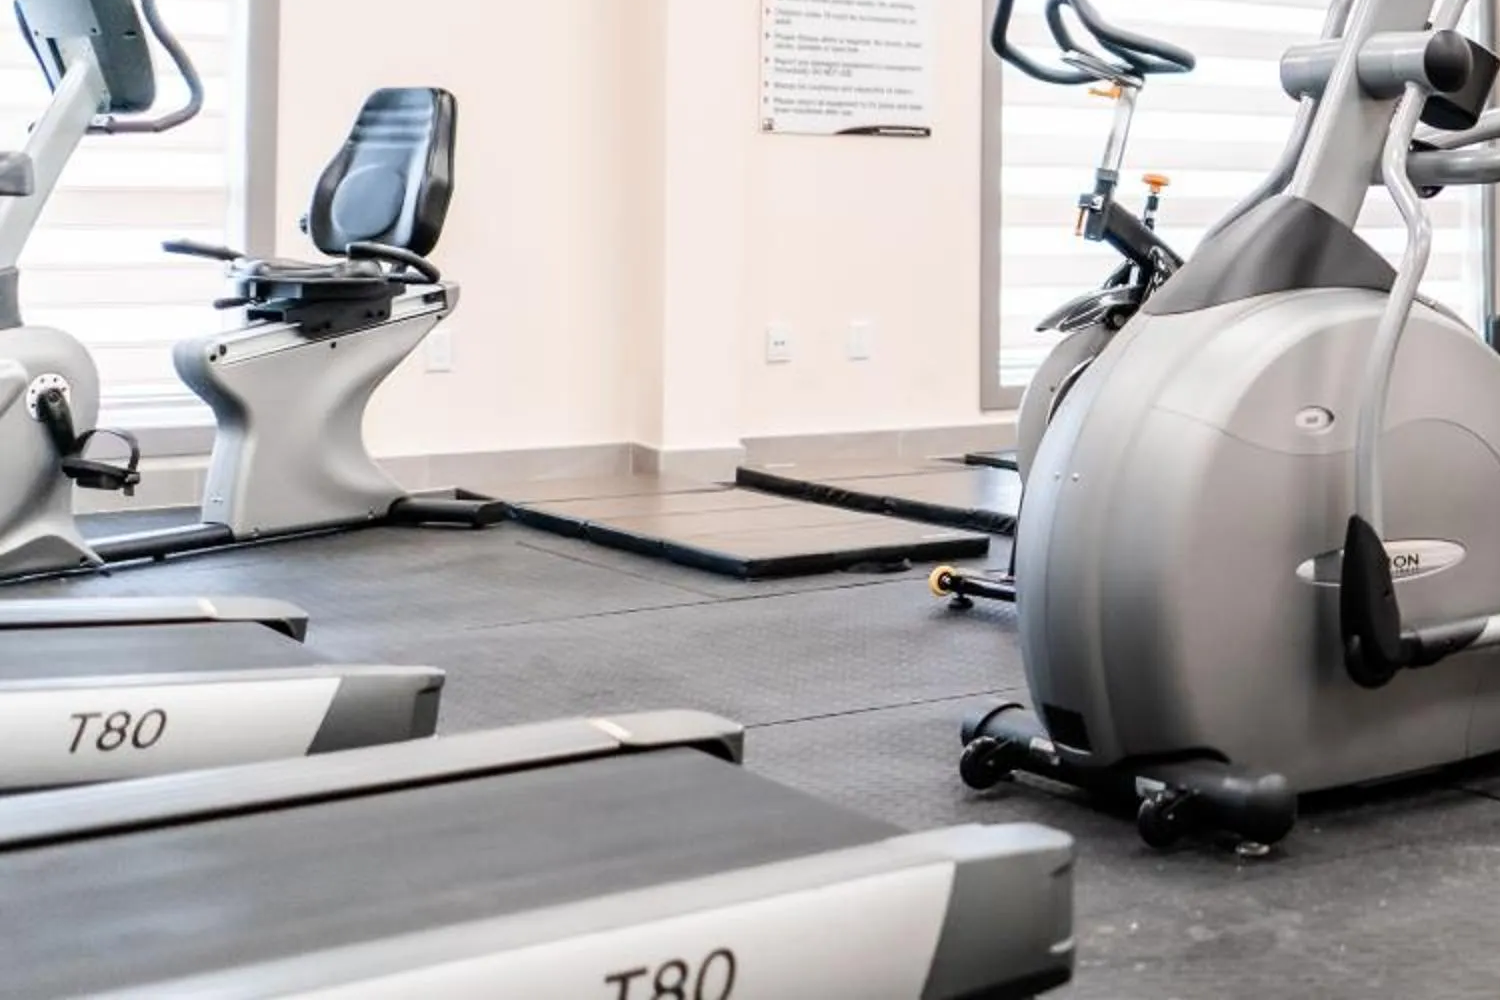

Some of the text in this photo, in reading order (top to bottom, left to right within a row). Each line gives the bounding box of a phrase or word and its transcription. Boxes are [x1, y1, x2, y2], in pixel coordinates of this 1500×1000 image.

[1389, 553, 1419, 569] ON
[69, 708, 168, 754] T80
[604, 947, 737, 1000] T80
